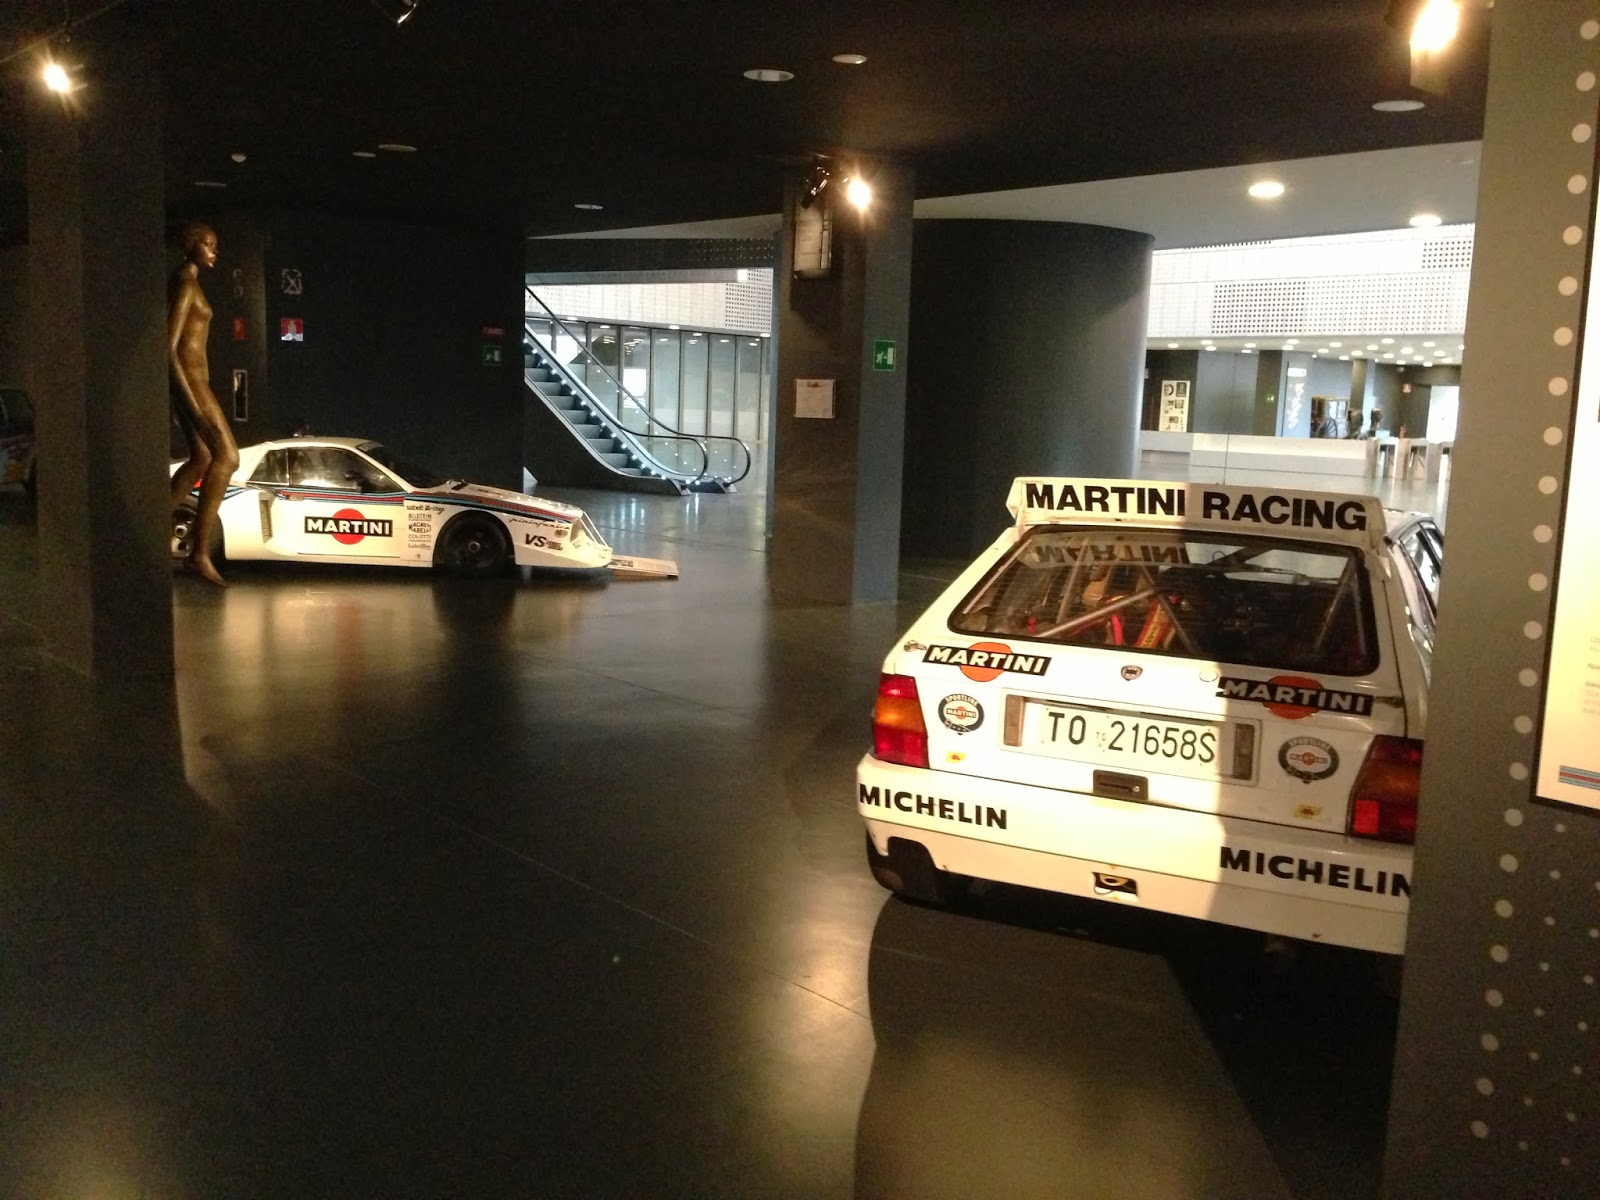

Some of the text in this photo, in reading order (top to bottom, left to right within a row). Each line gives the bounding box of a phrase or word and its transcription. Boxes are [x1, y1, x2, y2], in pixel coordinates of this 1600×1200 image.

[1026, 484, 1367, 532] MARTINI RACING
[307, 519, 390, 535] MARTINI
[525, 533, 548, 548] VS
[928, 646, 1046, 674] MARTINI
[945, 694, 979, 706] SPORTLINE
[1224, 680, 1366, 712] MARTINI
[947, 708, 976, 718] MARTINI
[1048, 711, 1217, 763] TO 21658S
[859, 783, 1008, 830] MICHELIN
[1220, 846, 1411, 898] MICHELIN
